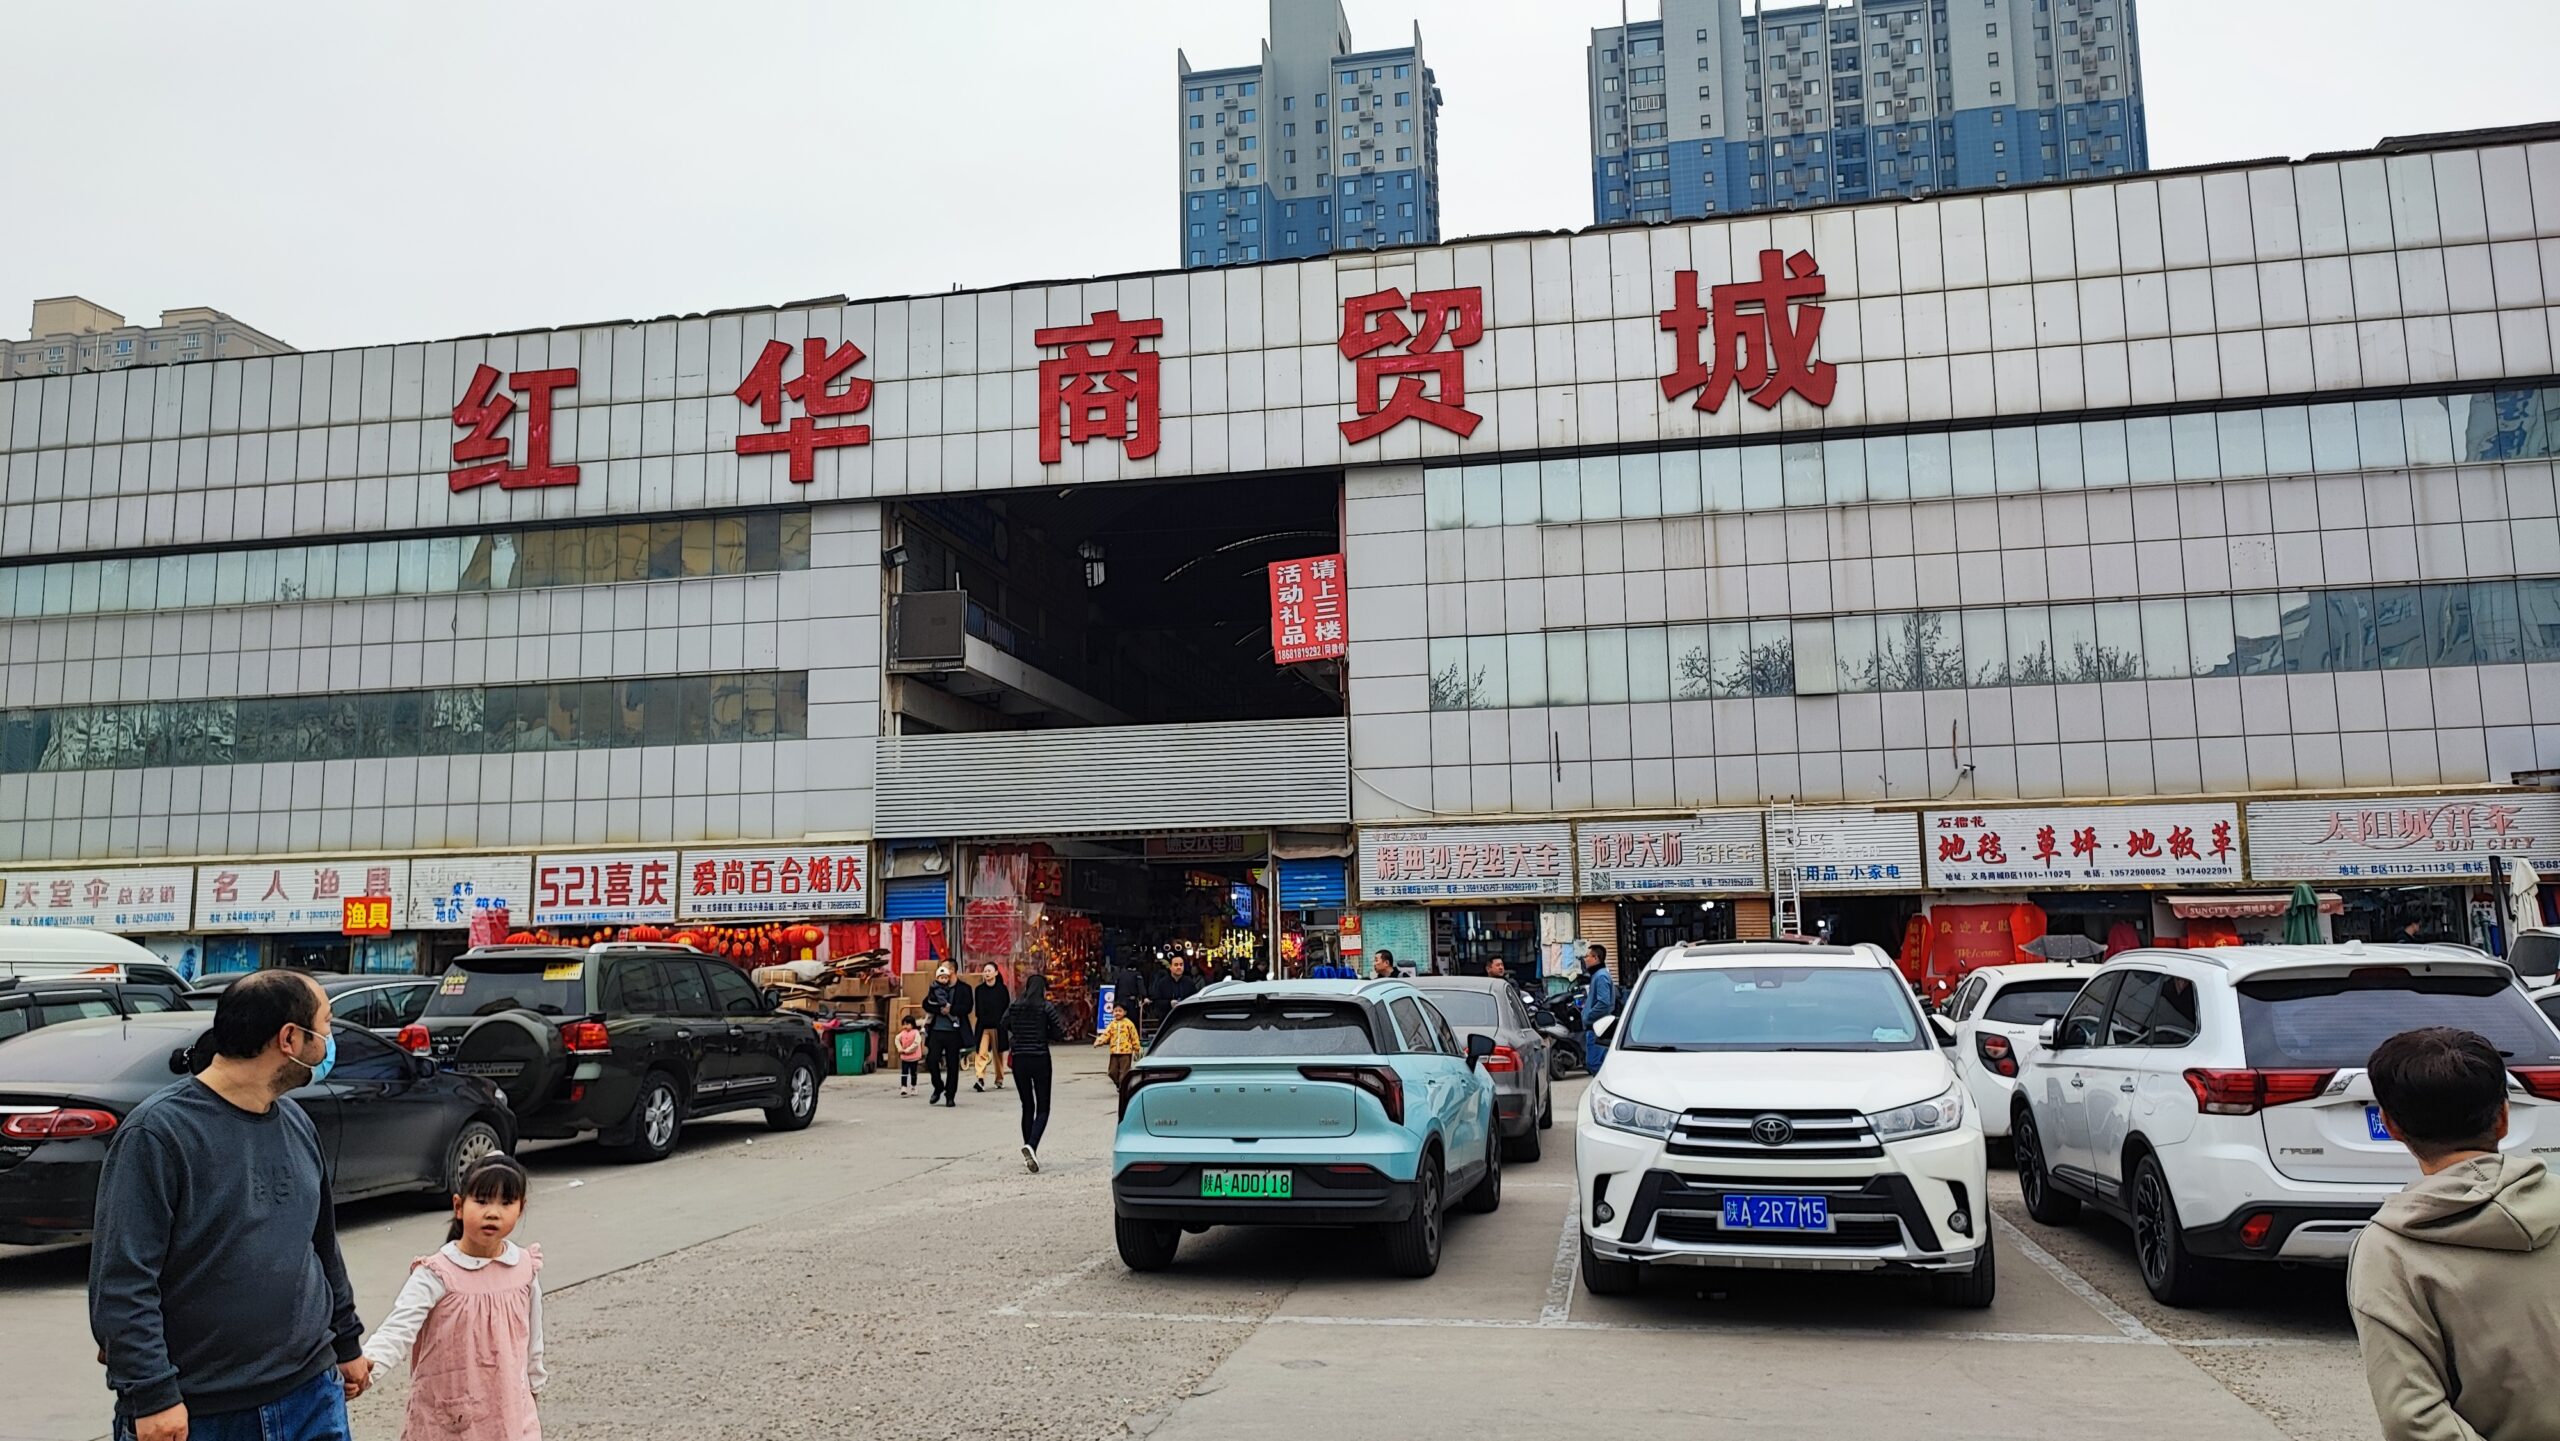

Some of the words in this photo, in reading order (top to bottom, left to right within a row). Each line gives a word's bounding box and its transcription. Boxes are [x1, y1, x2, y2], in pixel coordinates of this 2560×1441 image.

[449, 251, 1836, 491] 红华商贸城
[1277, 564, 1306, 646] 活动礼品
[1310, 560, 1342, 641] 请上三楼
[1937, 816, 1987, 828] 石榴花
[1376, 842, 1561, 880] 精典沙发垫大全
[1591, 832, 1683, 868] 拖把大师
[2435, 839, 2475, 851] SUN
[2487, 837, 2535, 850] CITY
[213, 868, 391, 902] 名人渔具
[540, 860, 670, 907] 521喜庆
[1796, 865, 1838, 881] 用品
[1850, 864, 1901, 880] 小家电
[14, 878, 110, 909] 天堂伞
[347, 902, 388, 928] 渔具
